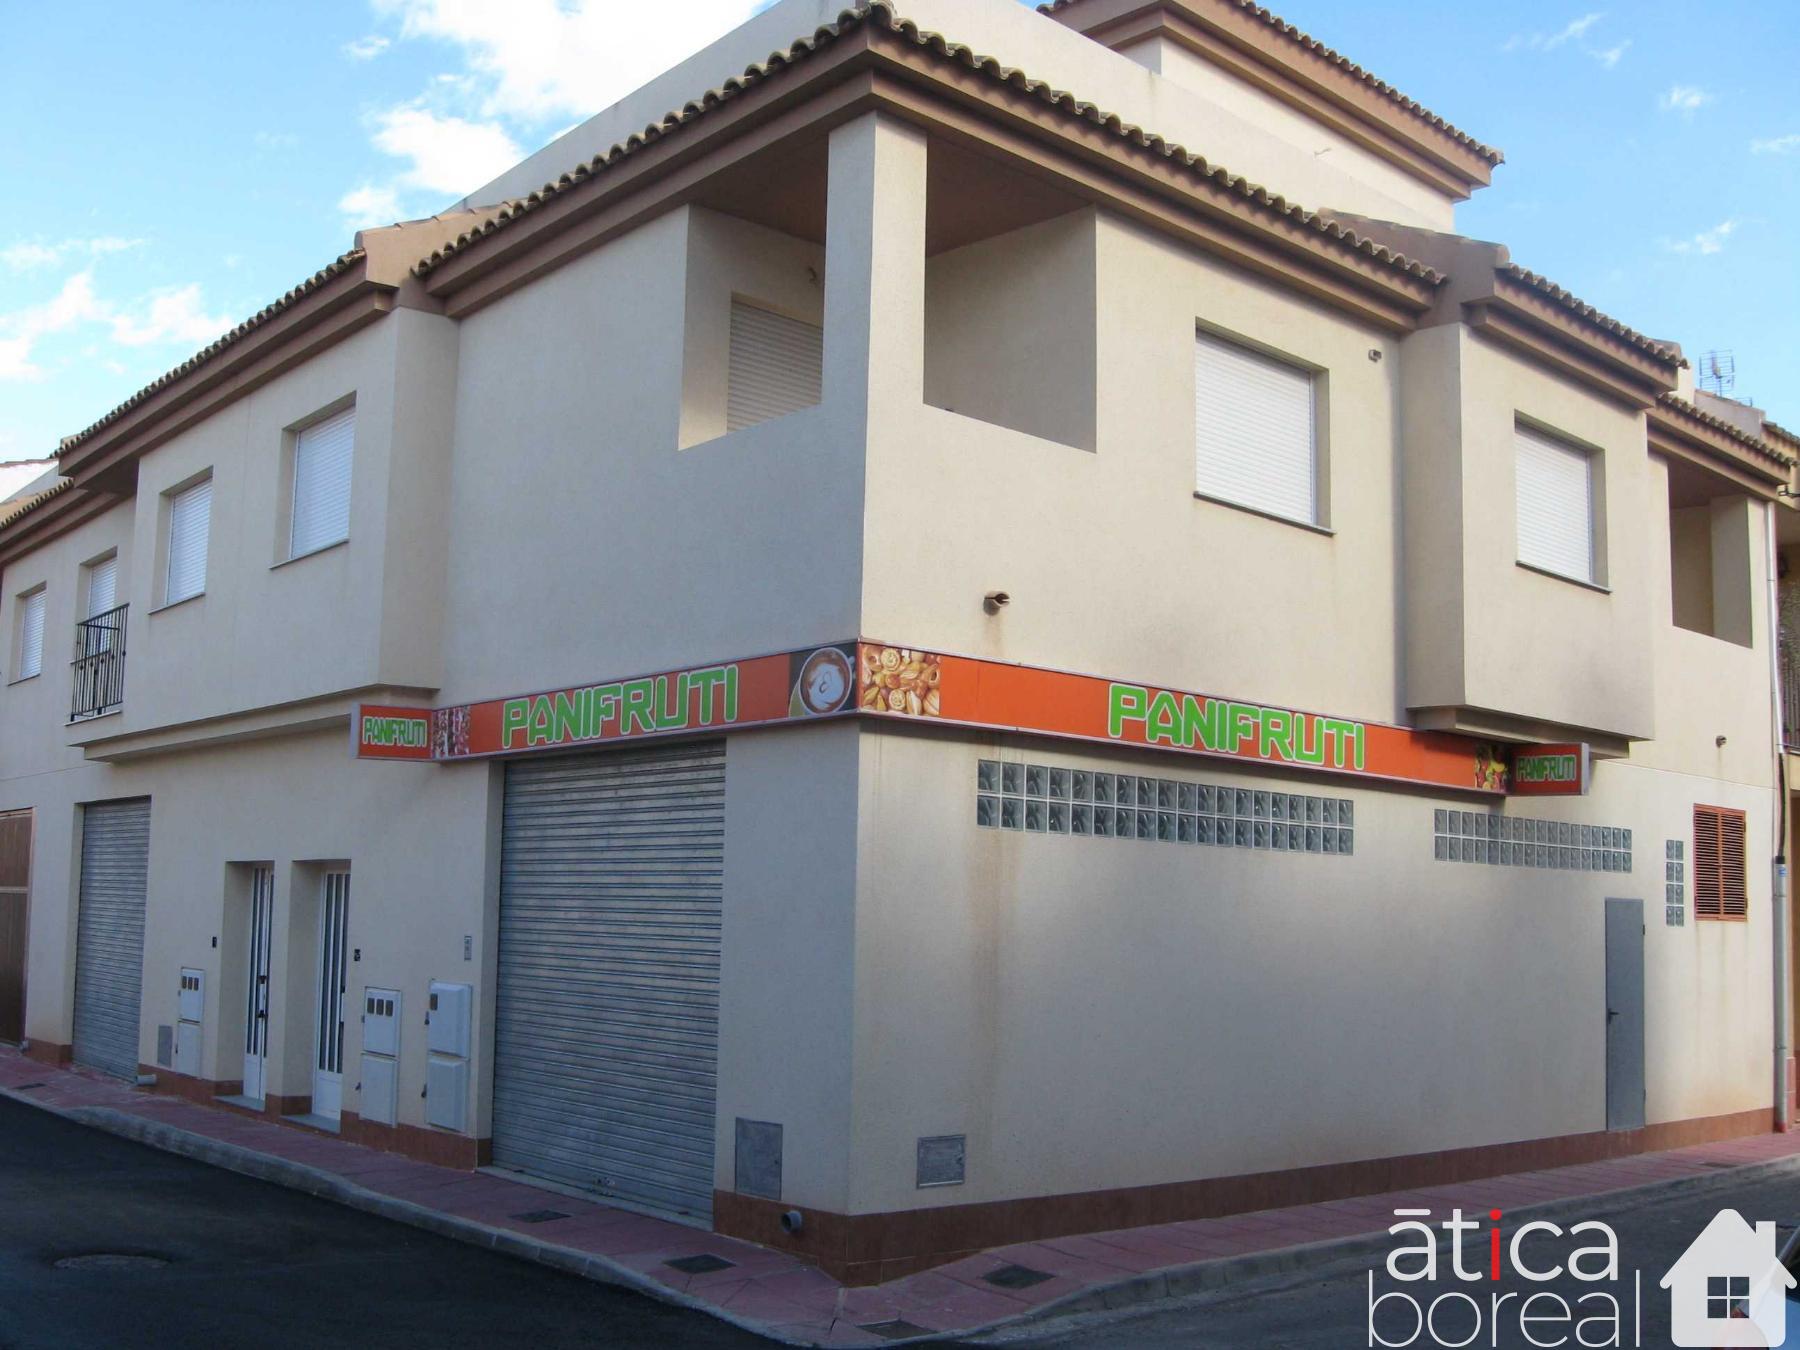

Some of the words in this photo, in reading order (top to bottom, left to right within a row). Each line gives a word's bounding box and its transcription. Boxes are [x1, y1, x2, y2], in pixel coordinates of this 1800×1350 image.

[362, 717, 428, 750] PANIFRUTI
[501, 665, 739, 750] PANIFRUTI
[1106, 682, 1366, 770] PANIFRUTI
[1515, 754, 1576, 783] PANIFRUTI
